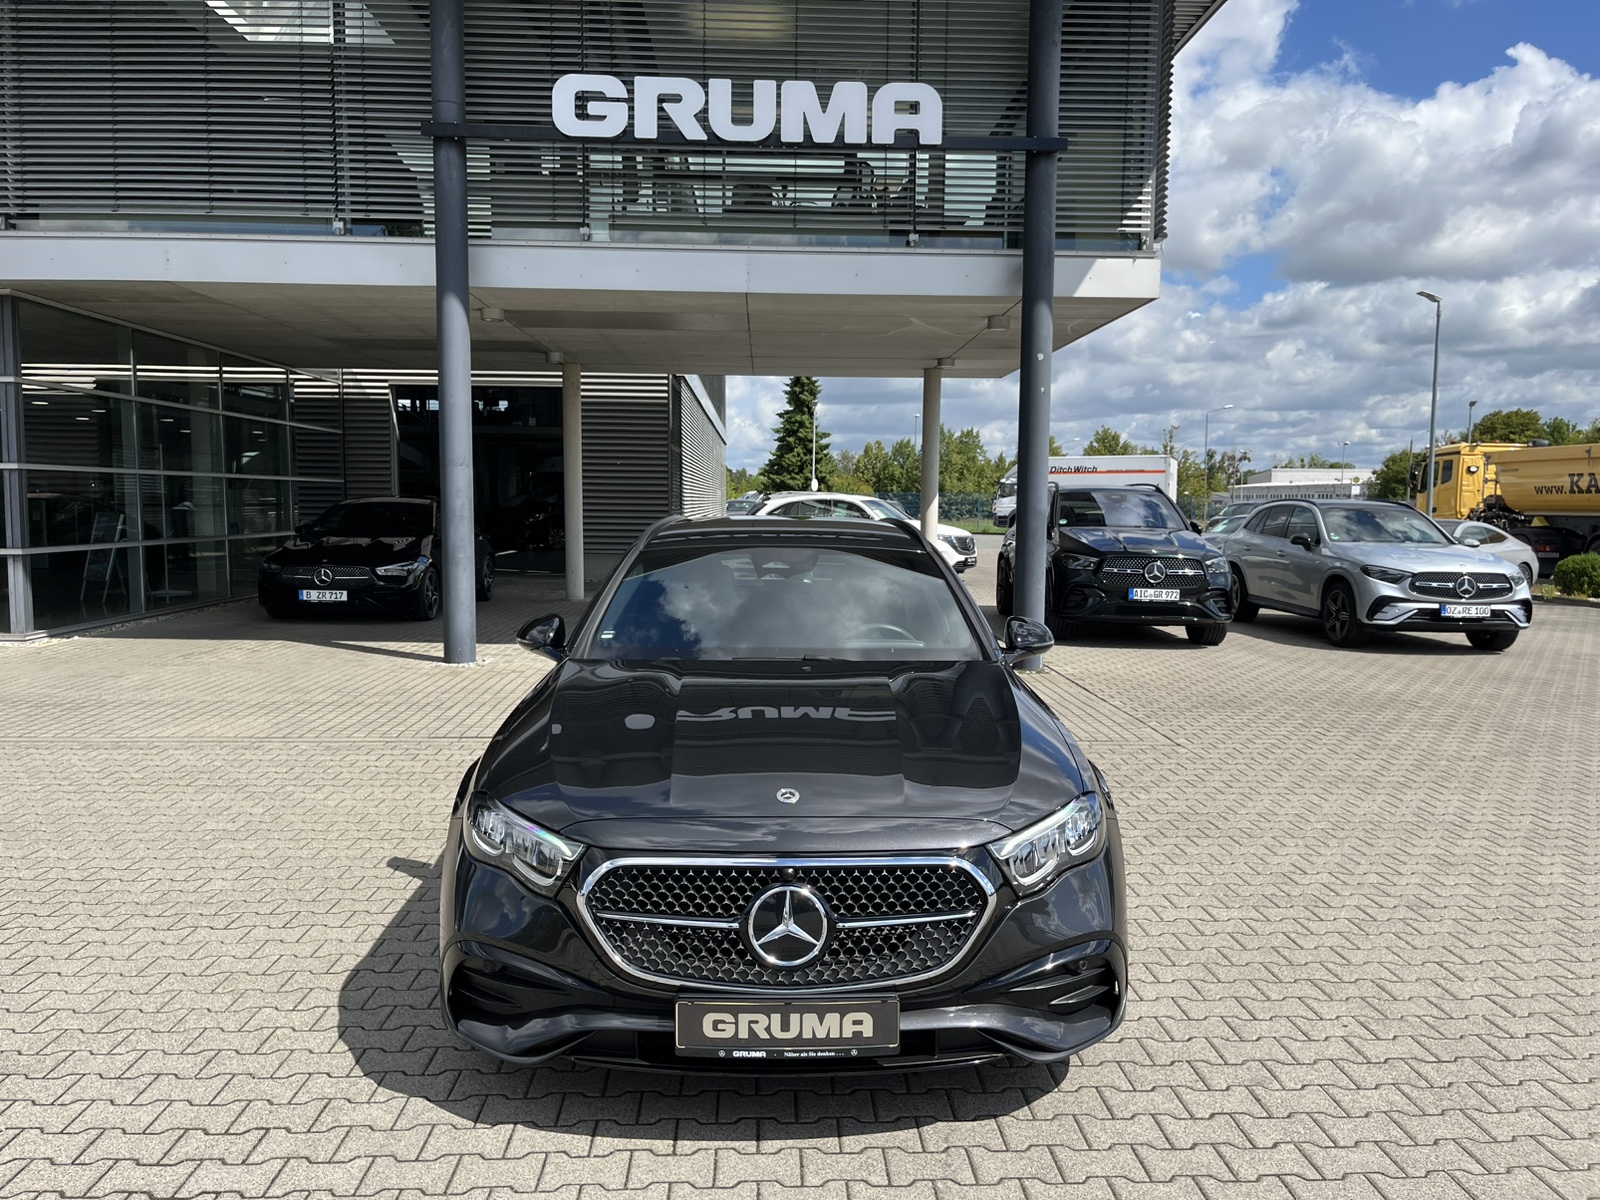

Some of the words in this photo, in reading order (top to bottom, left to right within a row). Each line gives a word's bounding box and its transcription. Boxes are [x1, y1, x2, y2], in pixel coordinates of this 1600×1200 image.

[551, 73, 943, 145] GRUMA
[1050, 466, 1073, 474] Ditch
[1073, 465, 1098, 473] Witch
[306, 591, 312, 599] B
[316, 591, 327, 600] ZR
[328, 591, 344, 600] 717
[1134, 590, 1149, 598] AIC
[1153, 590, 1164, 599] GR
[1165, 590, 1179, 600] 972
[1462, 606, 1473, 615] RE
[1474, 606, 1490, 616] 100
[702, 1012, 874, 1040] GRUMA
[732, 1050, 767, 1058] GRUMA
